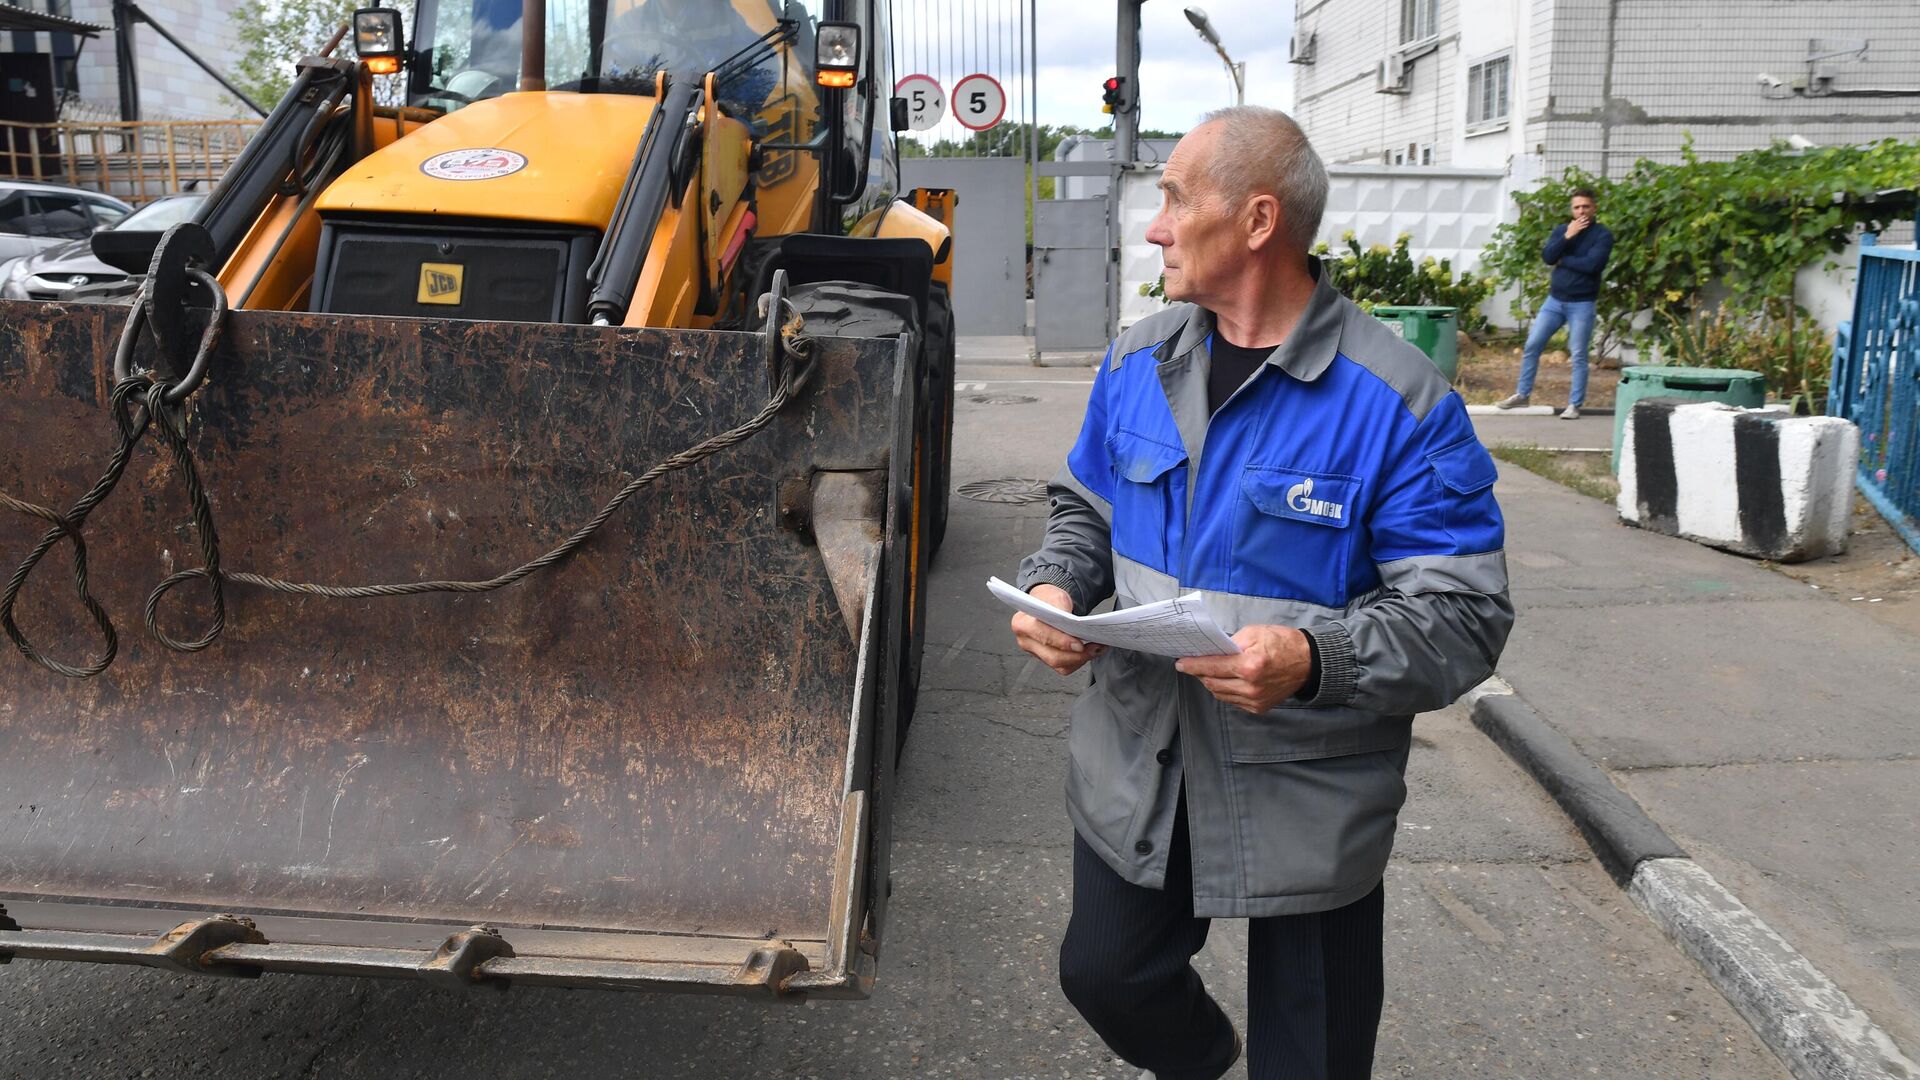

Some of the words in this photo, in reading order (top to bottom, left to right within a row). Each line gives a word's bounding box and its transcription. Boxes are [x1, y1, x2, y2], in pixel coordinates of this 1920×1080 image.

[913, 90, 926, 112] 5
[969, 92, 987, 114] 5
[428, 271, 456, 295] JCB
